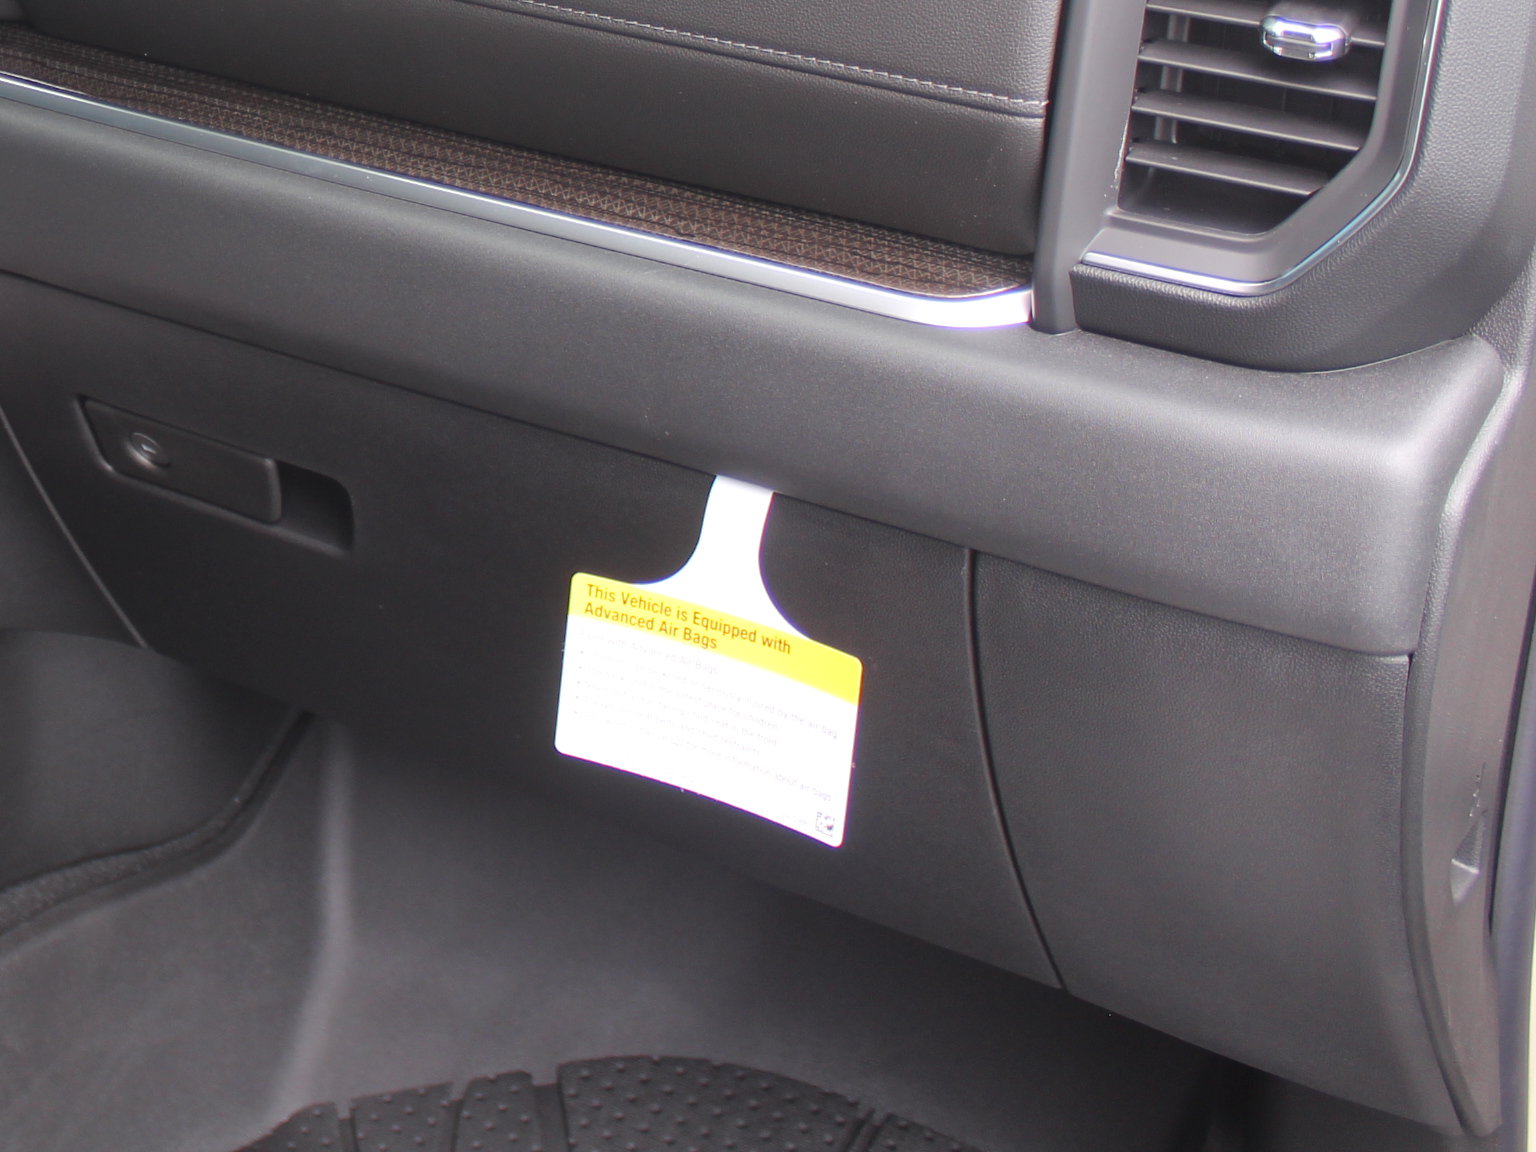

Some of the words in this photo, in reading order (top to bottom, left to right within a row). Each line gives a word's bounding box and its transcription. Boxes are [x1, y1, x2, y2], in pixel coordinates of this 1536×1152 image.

[585, 602, 655, 630] Advanced
[659, 620, 679, 637] Air
[683, 627, 718, 650] Bags
[586, 584, 616, 603] This
[622, 592, 672, 618] Vehicle
[677, 607, 688, 623] is
[693, 612, 757, 643] Equipped
[761, 633, 791, 655] with
